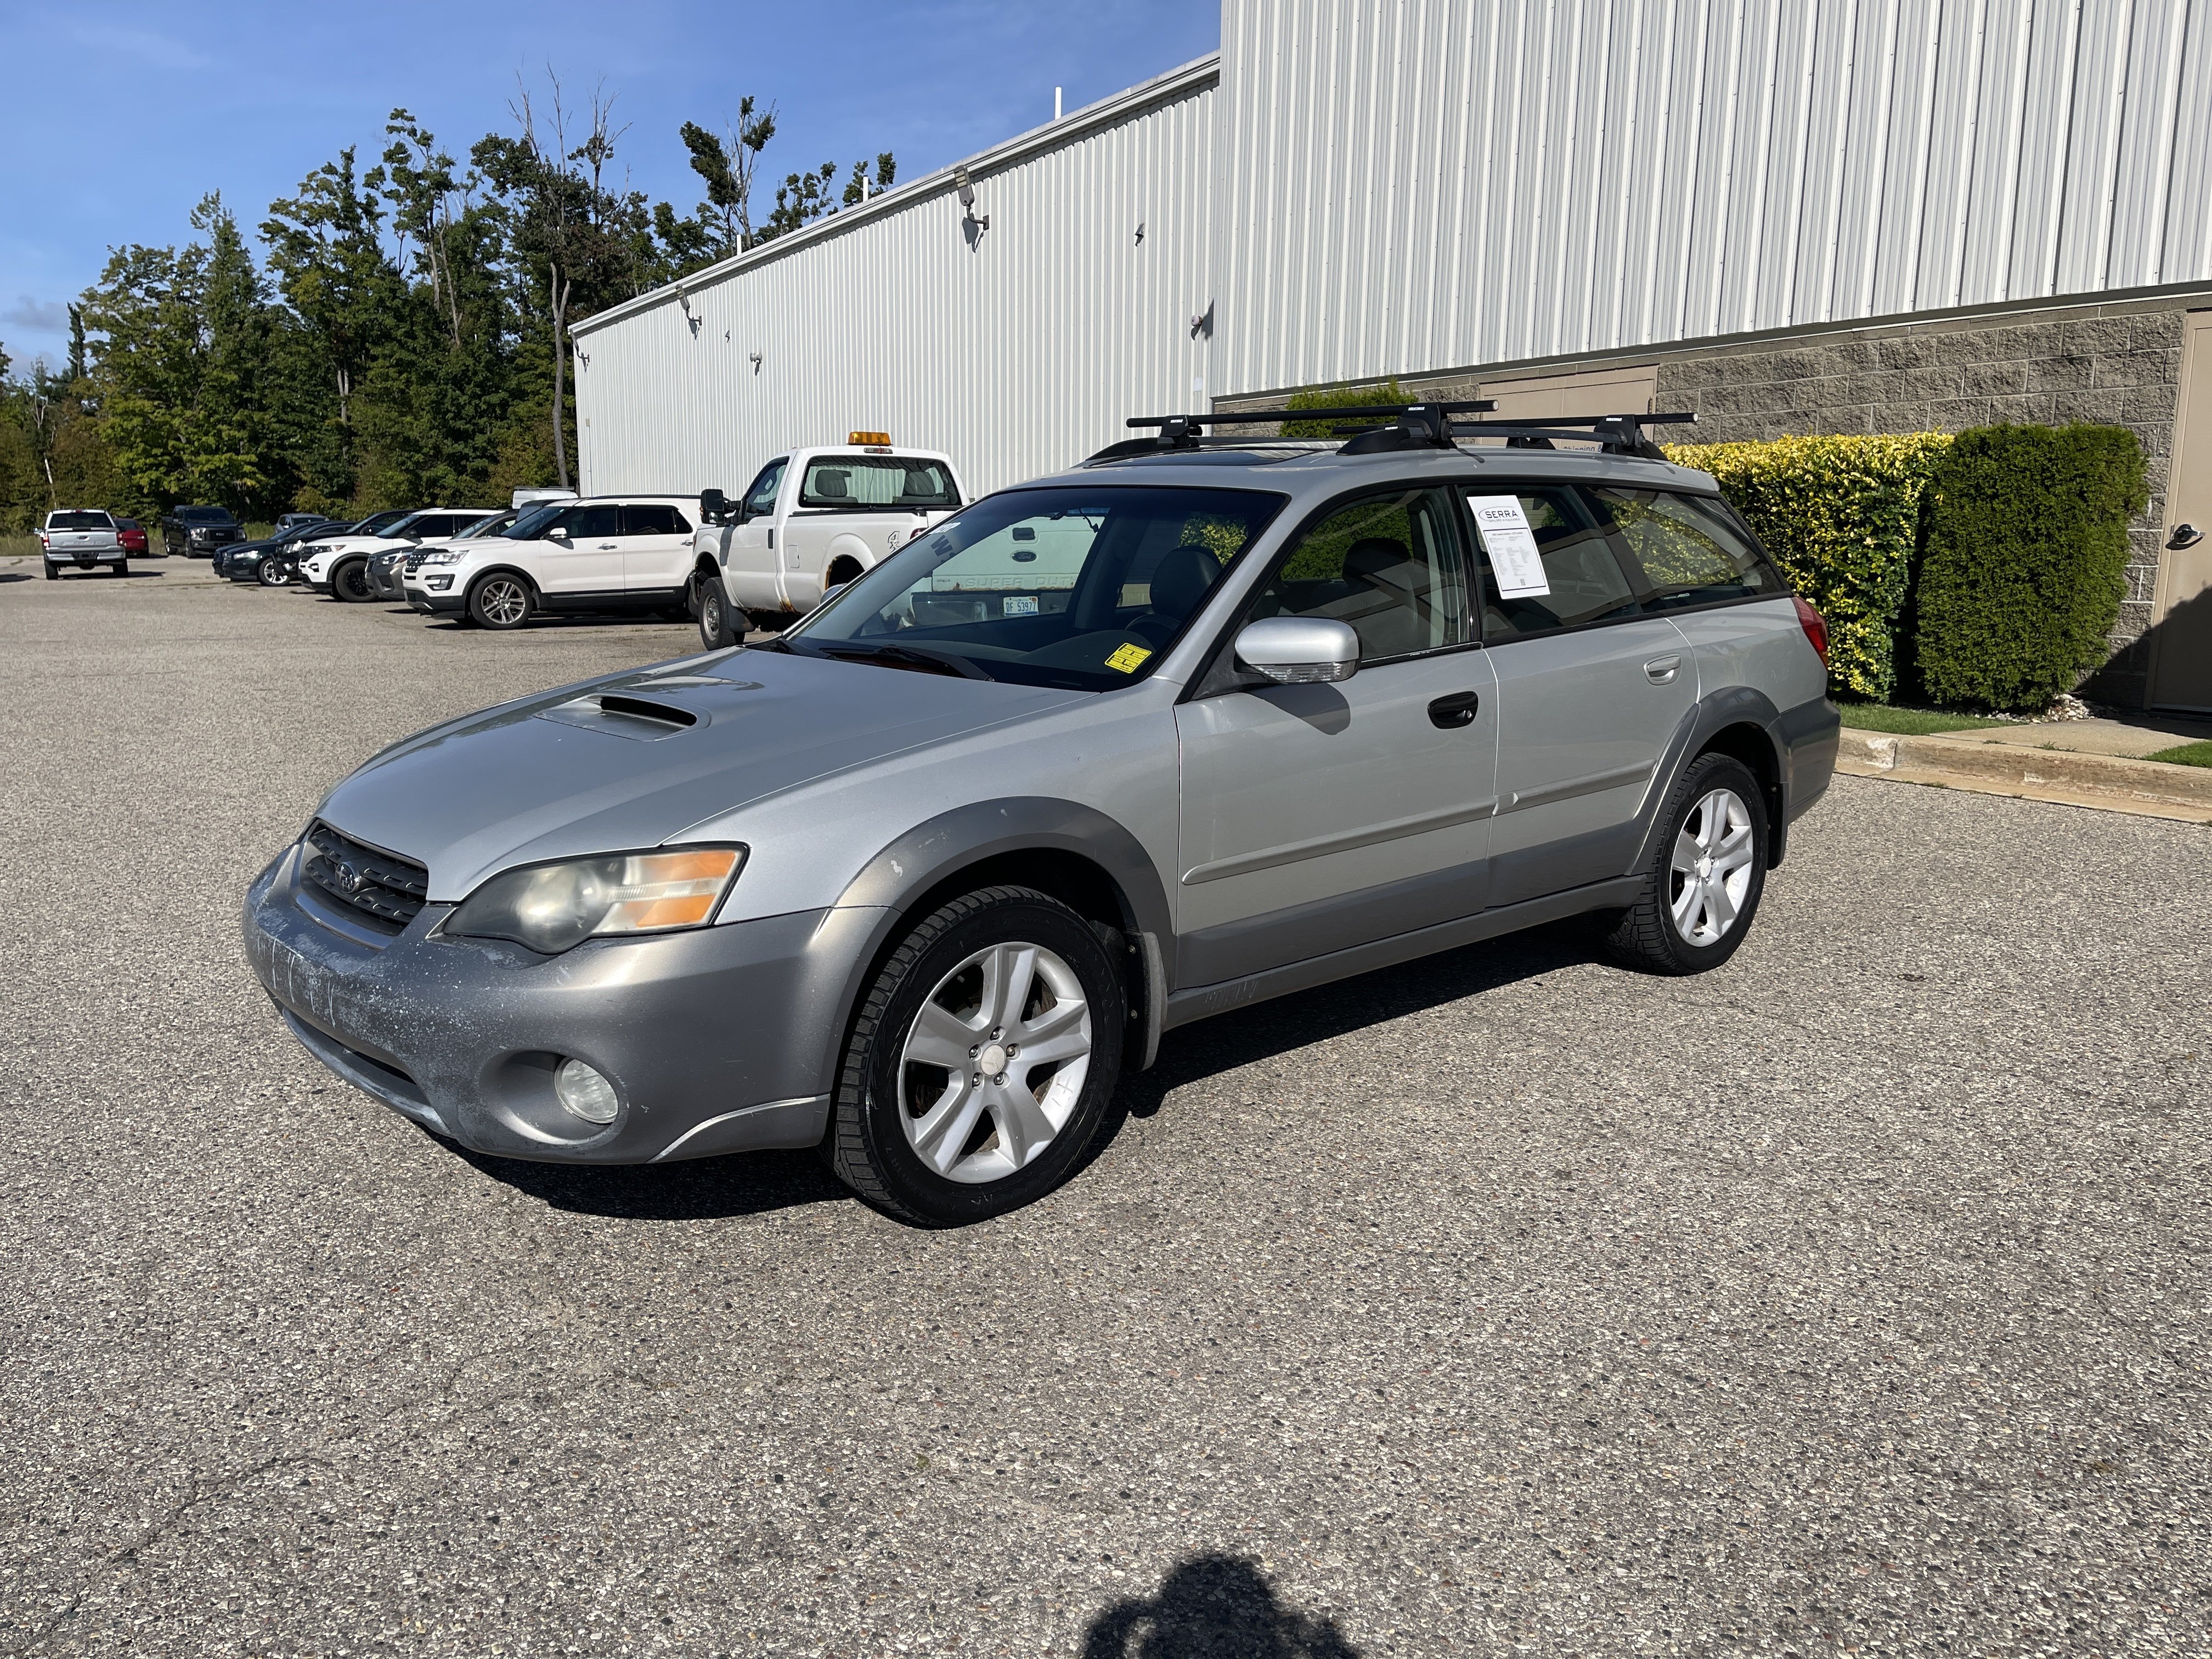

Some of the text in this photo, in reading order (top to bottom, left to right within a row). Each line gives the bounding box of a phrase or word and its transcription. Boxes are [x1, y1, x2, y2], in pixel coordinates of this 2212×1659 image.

[1485, 510, 1519, 518] SERRA
[966, 577, 1023, 588] SUPER
[1006, 602, 1013, 612] DF
